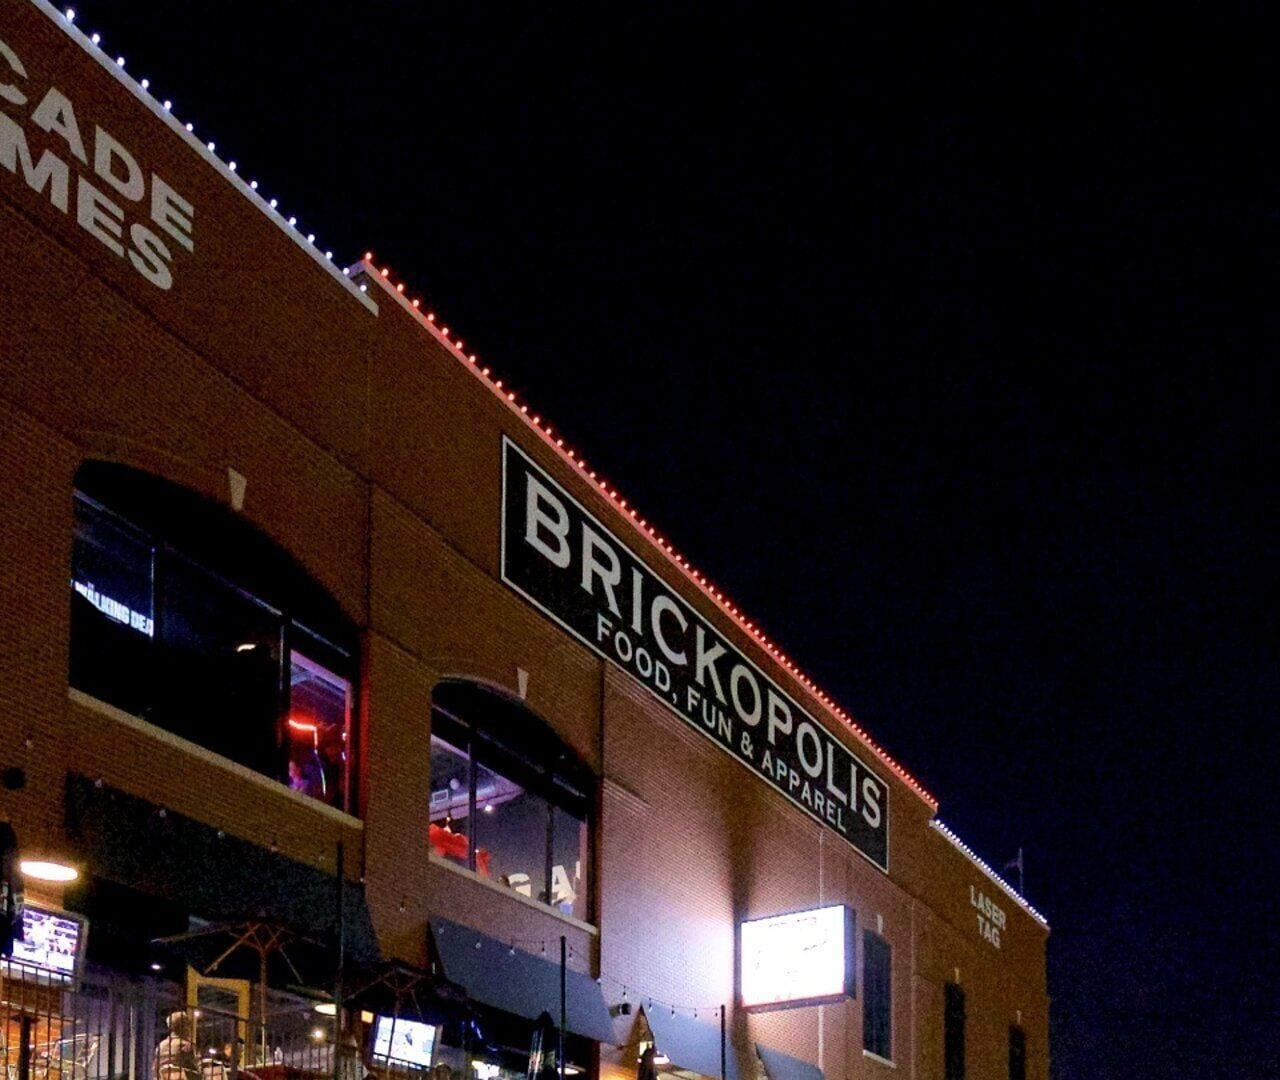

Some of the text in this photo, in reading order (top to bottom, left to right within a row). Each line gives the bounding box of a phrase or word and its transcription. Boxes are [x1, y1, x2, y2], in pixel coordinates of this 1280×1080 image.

[524, 470, 882, 829] BRICKOPOLIS
[596, 613, 847, 833] FOOD, FUN & APPAREL
[969, 885, 1006, 931] LASER
[977, 914, 1000, 949] TAG
